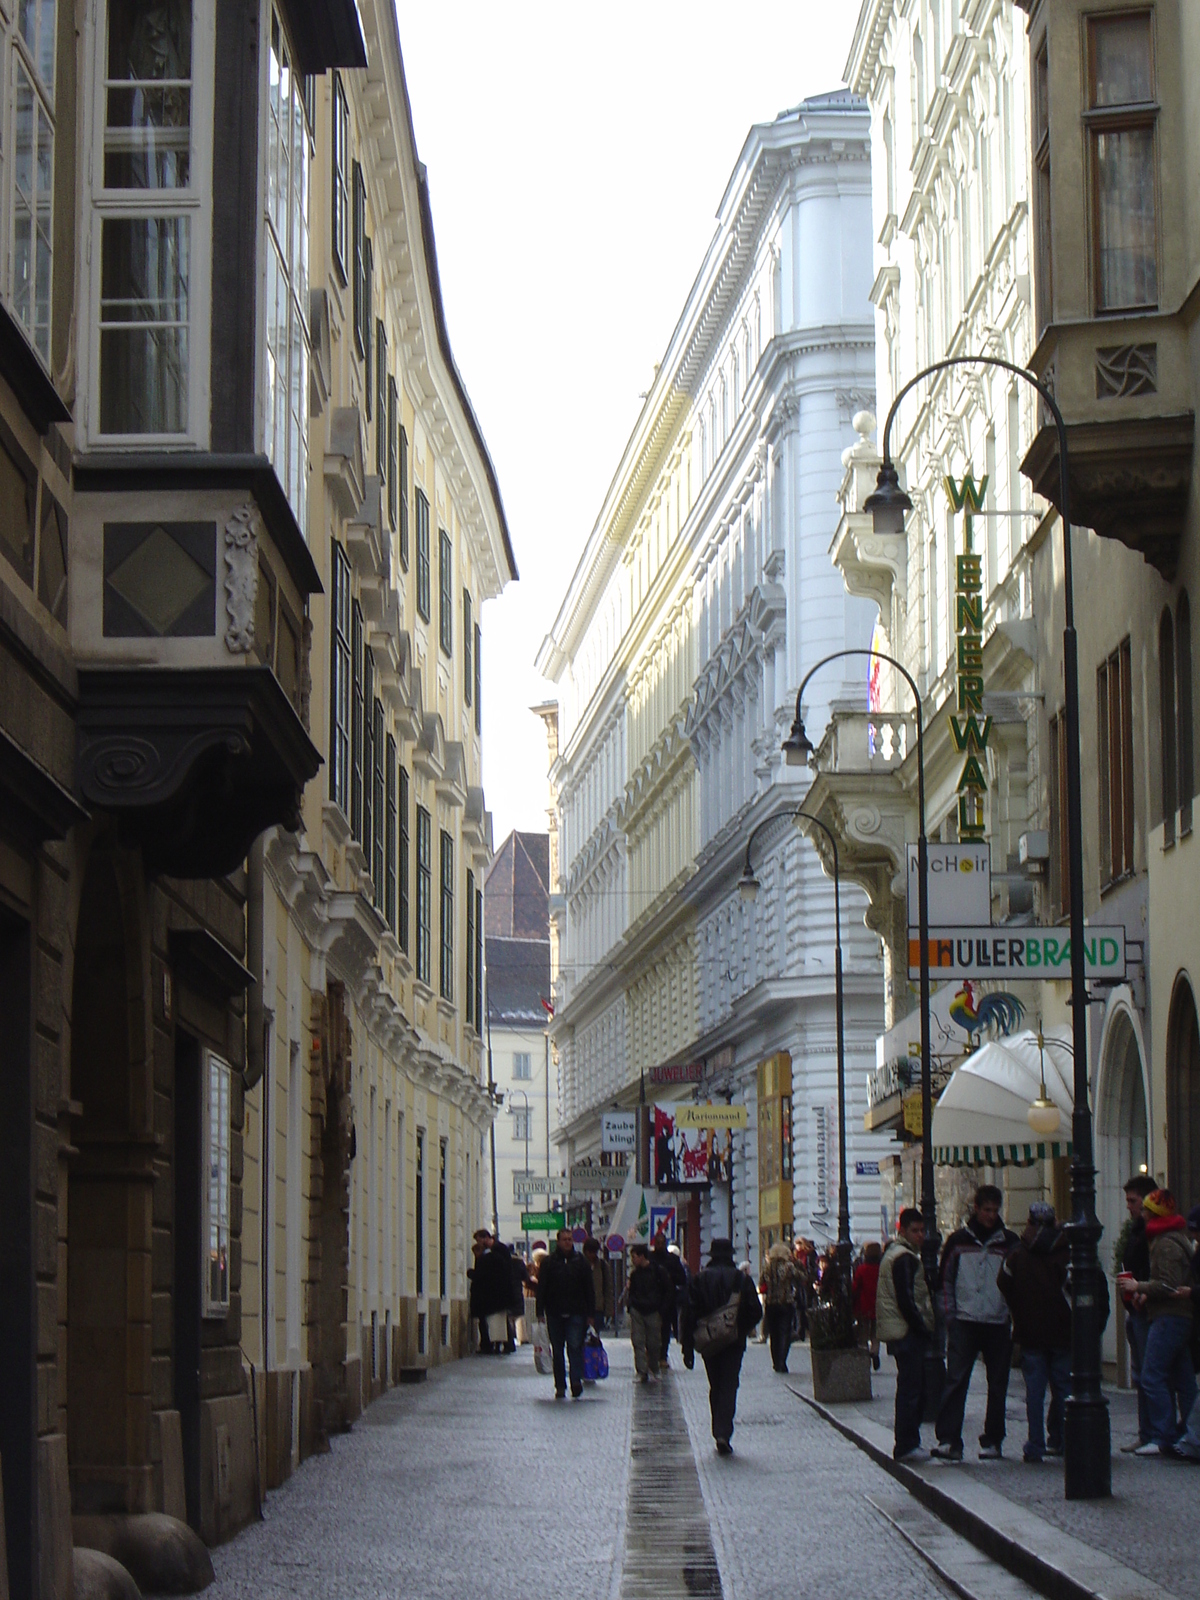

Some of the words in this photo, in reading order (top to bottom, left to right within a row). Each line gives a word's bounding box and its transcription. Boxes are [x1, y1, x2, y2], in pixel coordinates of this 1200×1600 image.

[943, 474, 993, 843] WIENERWAL
[651, 1064, 702, 1081] JUWELIER
[605, 1121, 635, 1130] Zaube
[809, 1105, 835, 1241] Marionnaud
